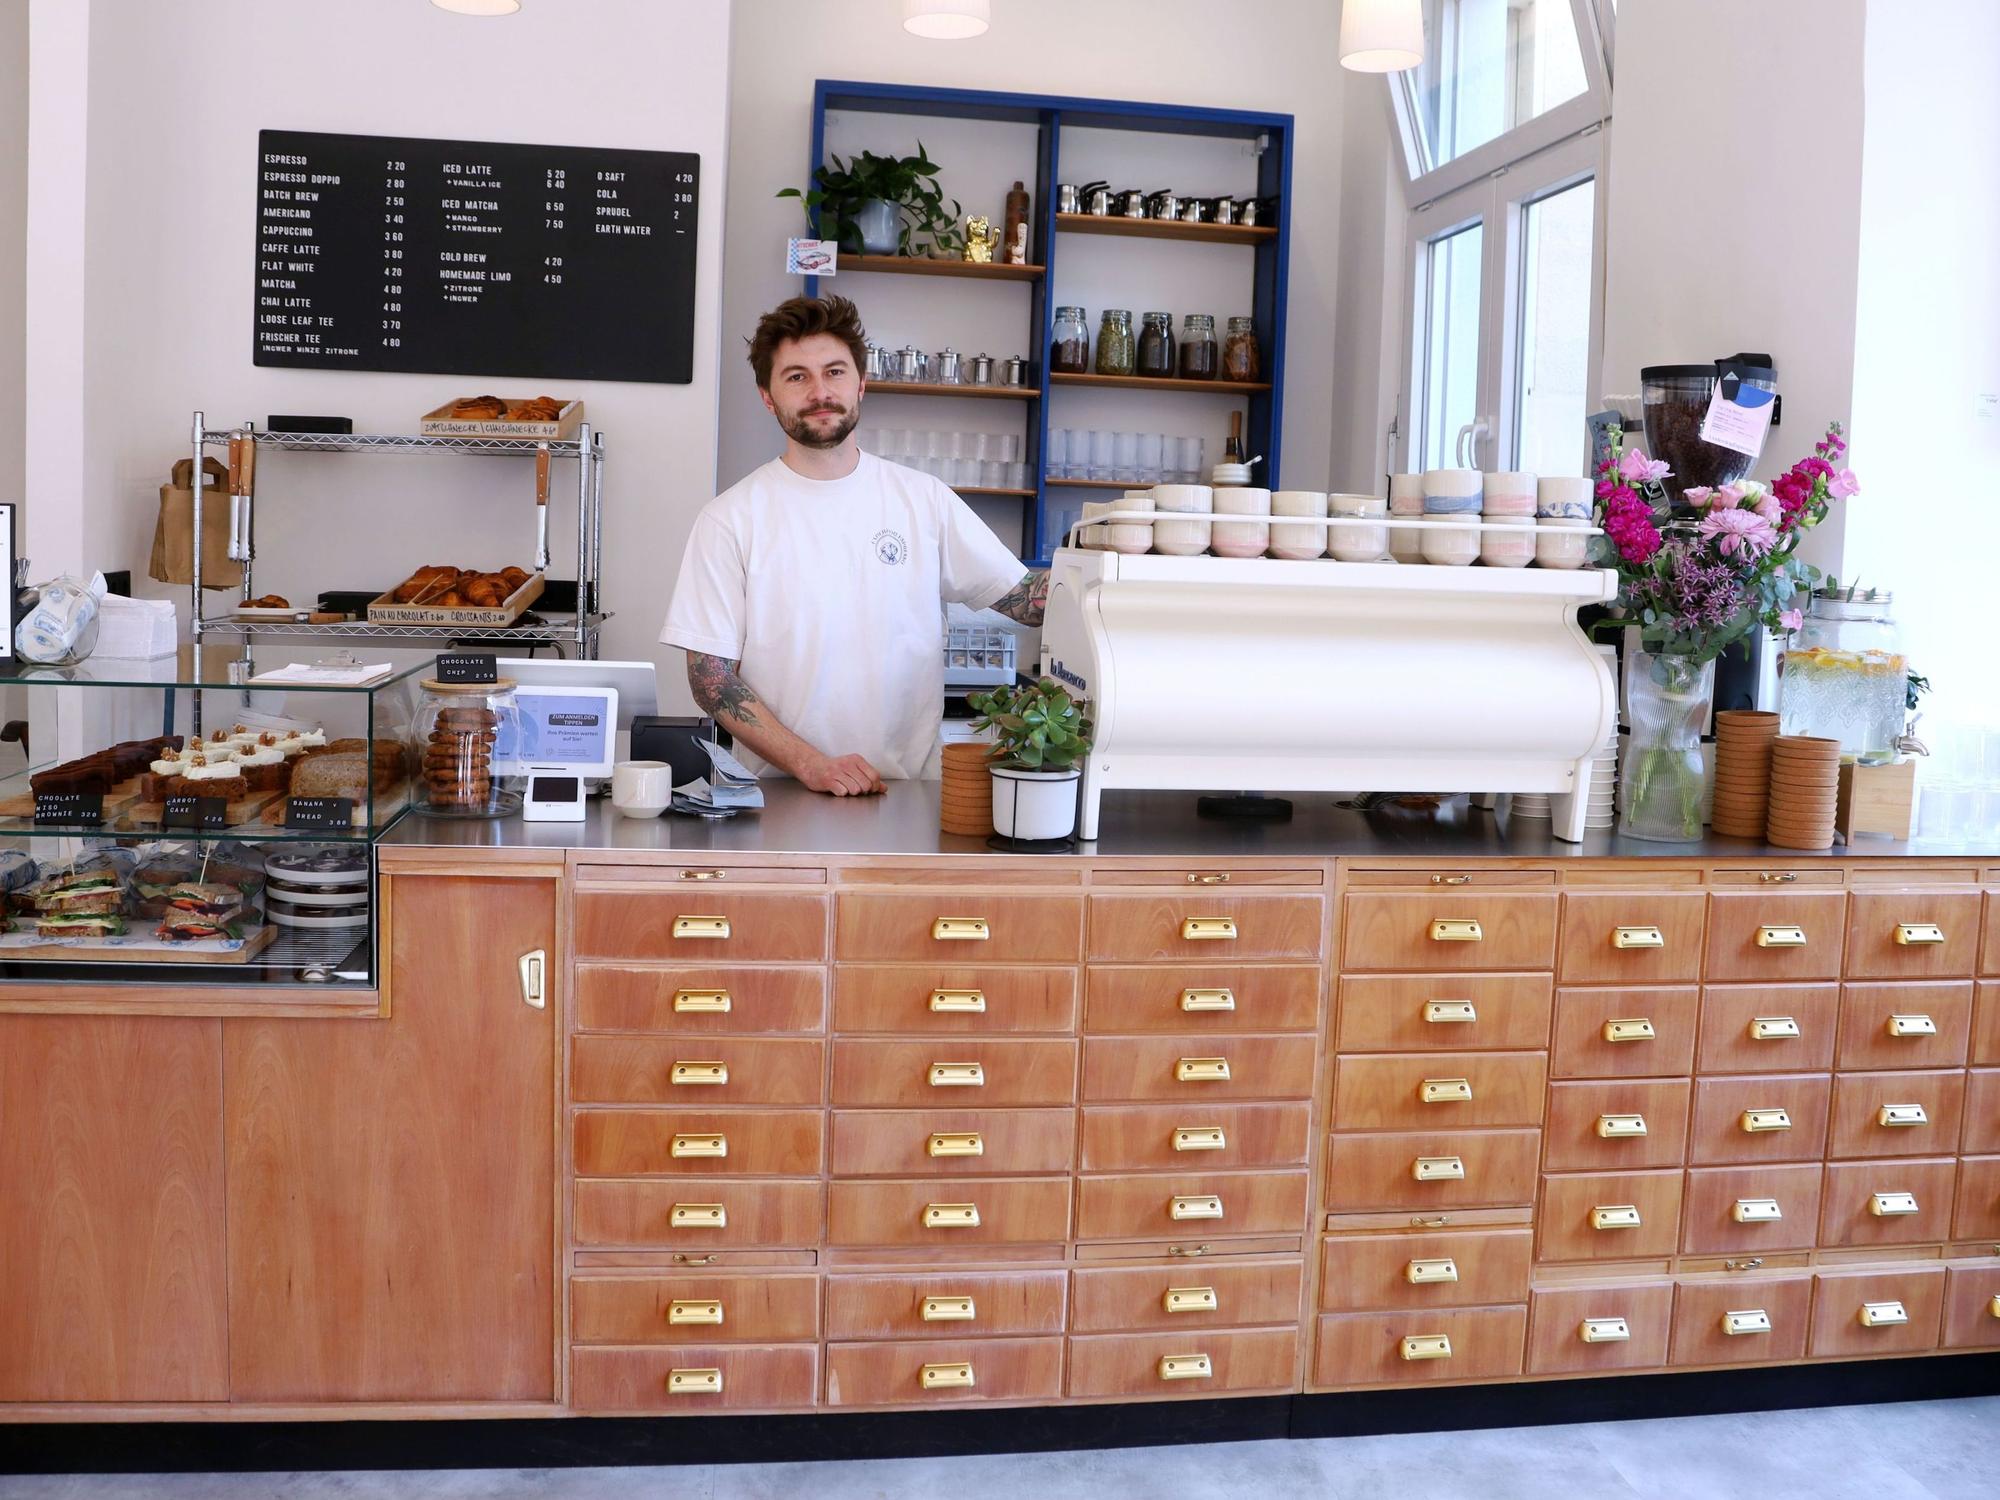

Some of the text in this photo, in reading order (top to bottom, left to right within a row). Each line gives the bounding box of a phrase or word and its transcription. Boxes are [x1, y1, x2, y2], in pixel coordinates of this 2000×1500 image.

[265, 154, 307, 165] ESPRESSO
[443, 164, 491, 175] ICED LATTE
[265, 172, 340, 184] ESPRESSO DOPPIO
[605, 172, 624, 181] SAFT
[264, 190, 318, 201] BATCH BREW
[597, 190, 617, 198] COLA
[442, 200, 498, 210] ICED MATCHA
[264, 208, 310, 218] AMERICANO
[596, 207, 631, 217] SPRUDEL
[263, 226, 312, 236] CAPPUCCINO
[596, 224, 650, 235] EARTH WATER
[263, 243, 320, 254] CAFFE LATTE
[441, 252, 486, 262] COLD BREW
[262, 261, 313, 272] FLAT WHITE
[440, 270, 511, 281] HOMEMADE LIMO
[262, 279, 295, 288] MATCHA
[261, 297, 310, 307] CHAI LATTE
[261, 315, 333, 326] LOOSE LEAF TEE
[261, 333, 320, 343] FRISCHER TEE
[369, 610, 386, 620] PAIN
[387, 611, 395, 620] AU
[396, 610, 429, 621] CHOCOLAT
[166, 797, 197, 807] CARROT
[35, 810, 73, 819] BROWNIE
